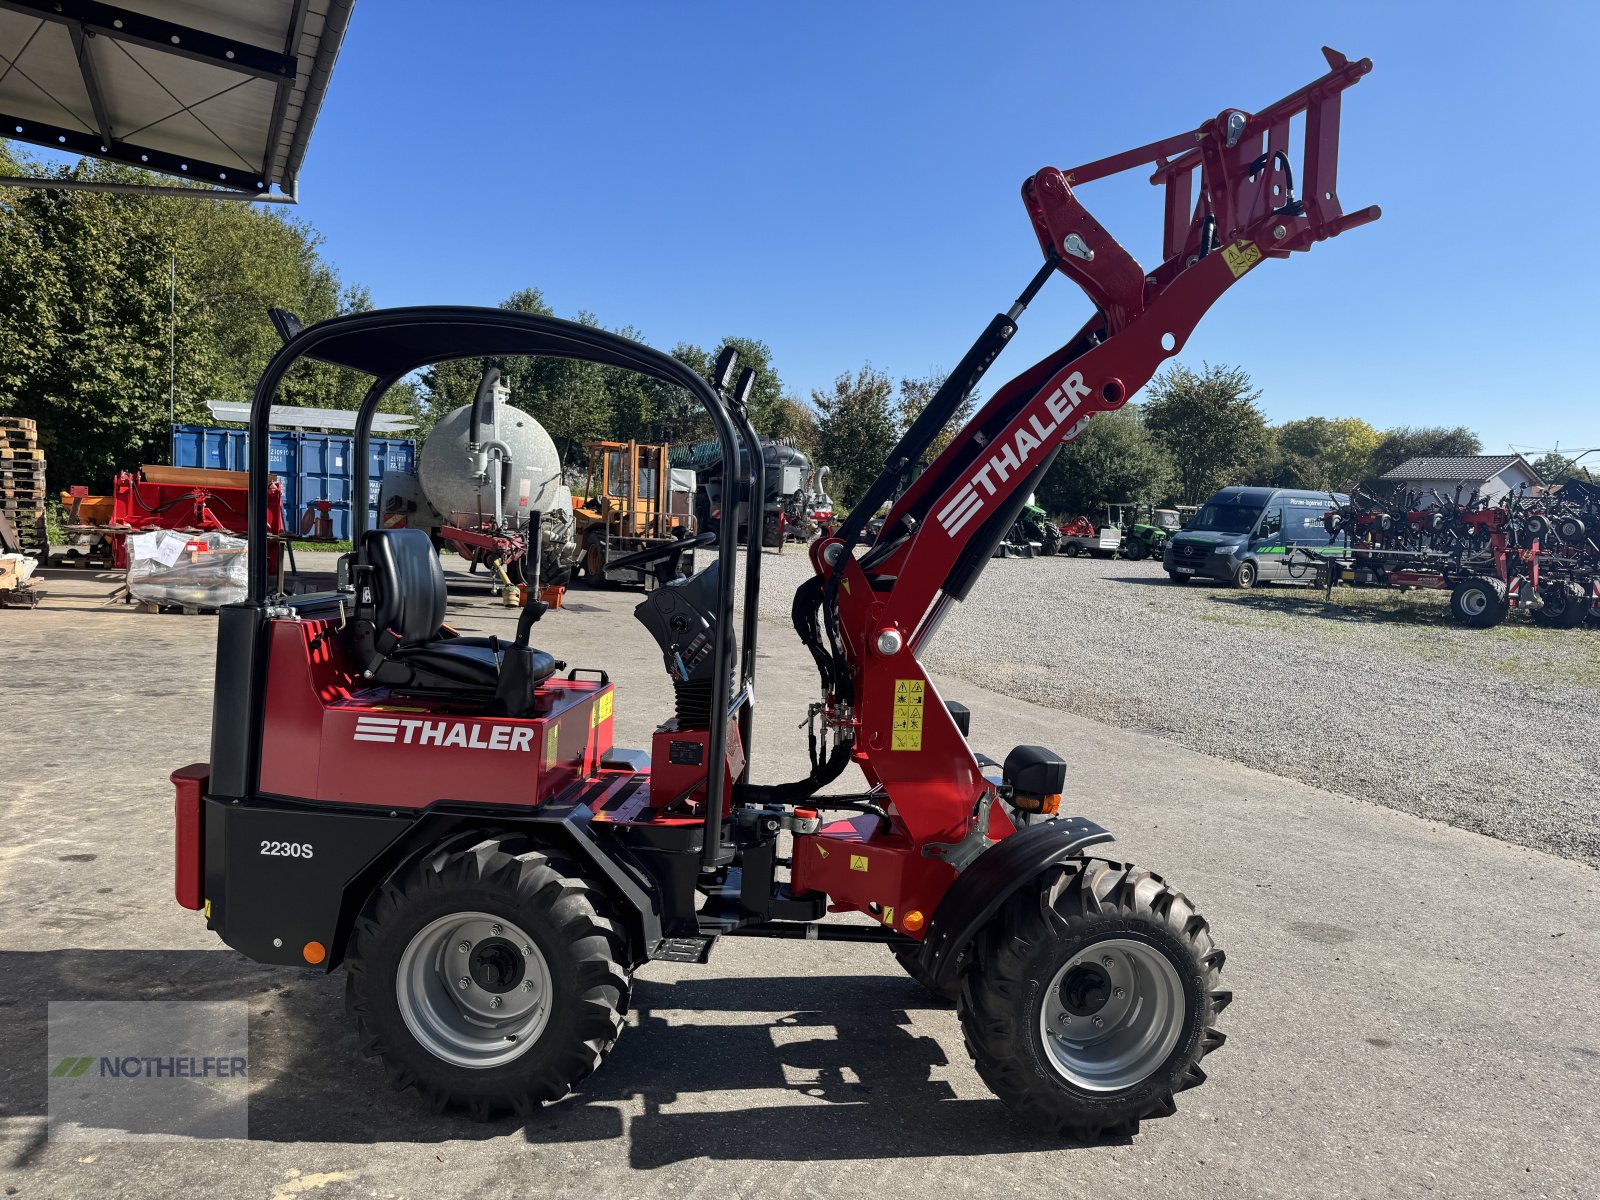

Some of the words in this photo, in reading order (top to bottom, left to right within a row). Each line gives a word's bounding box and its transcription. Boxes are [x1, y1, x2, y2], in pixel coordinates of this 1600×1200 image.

[971, 371, 1092, 496] THALER
[400, 719, 535, 752] THALER
[260, 840, 313, 859] 2230S
